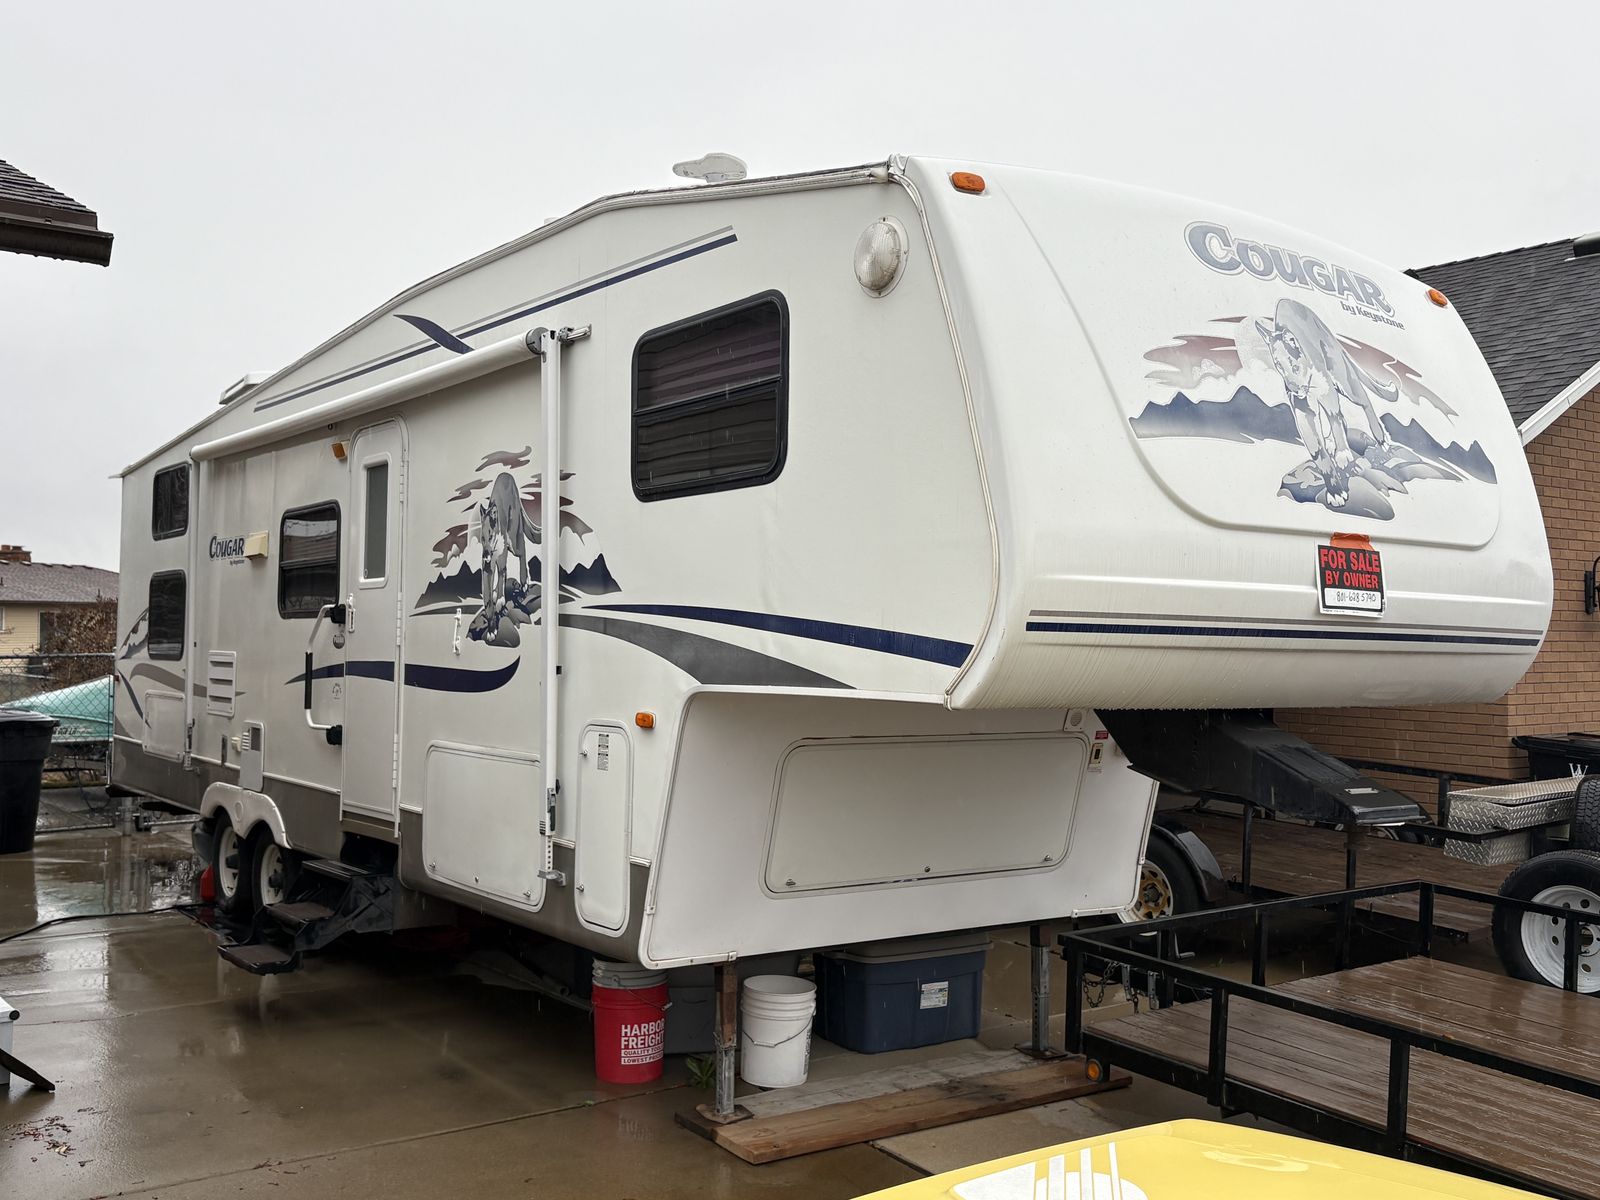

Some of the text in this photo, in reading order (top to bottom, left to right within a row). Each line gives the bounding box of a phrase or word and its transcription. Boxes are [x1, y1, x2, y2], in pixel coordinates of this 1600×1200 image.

[1184, 221, 1395, 317] COUGAR
[1340, 301, 1405, 330] by Keystone
[209, 535, 244, 559] COUGAR
[1320, 549, 1380, 572] FOR SALE
[1325, 570, 1379, 589] BY OWNER
[621, 1030, 665, 1049] FREIGHT
